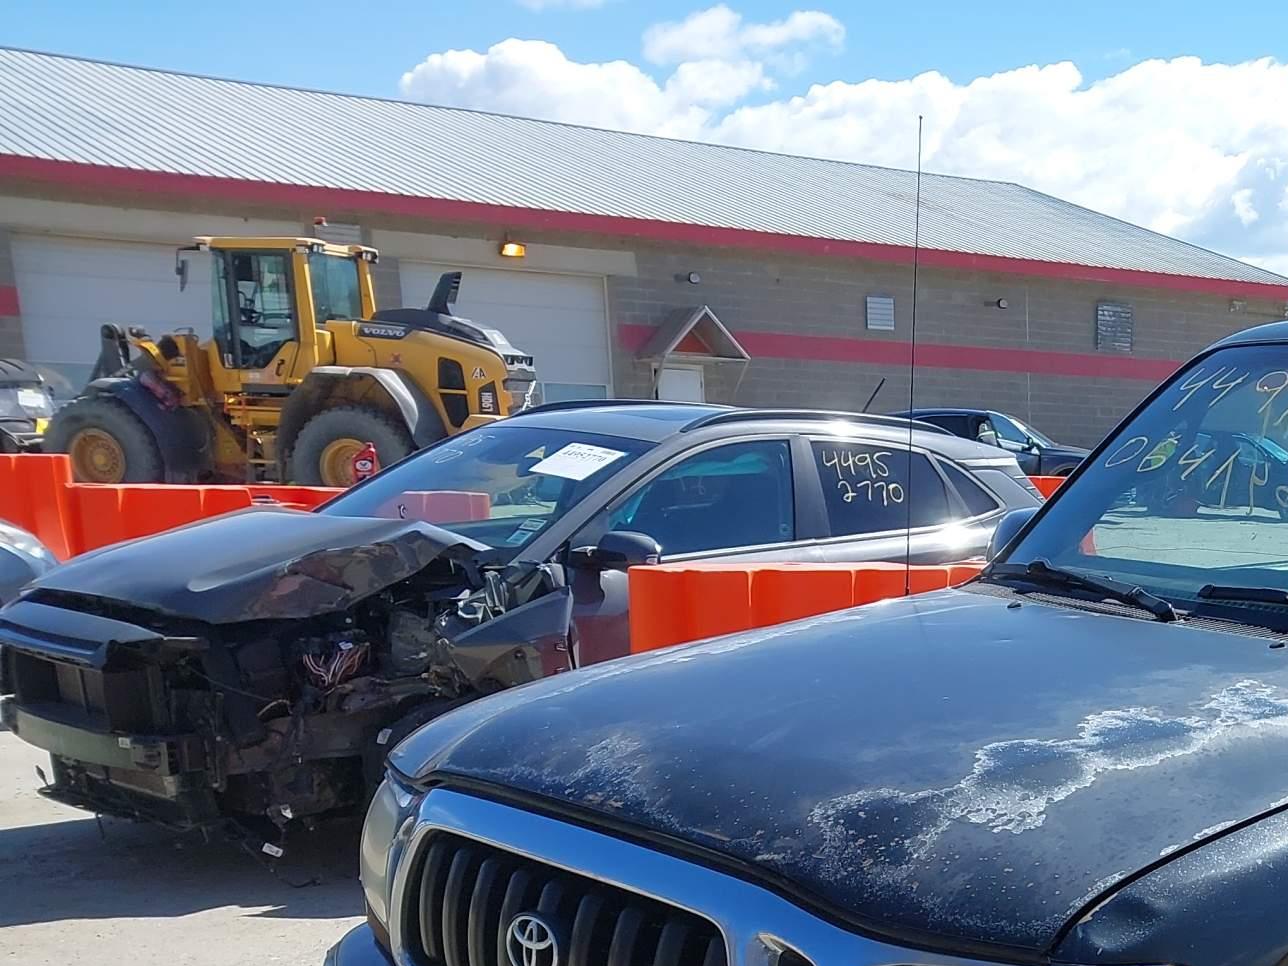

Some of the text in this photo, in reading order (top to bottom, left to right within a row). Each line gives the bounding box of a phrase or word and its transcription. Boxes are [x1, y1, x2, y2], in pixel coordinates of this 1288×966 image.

[363, 327, 406, 337] VOLVO
[481, 391, 494, 412] L90H
[822, 451, 893, 480] 4495
[837, 480, 904, 507] 2770
